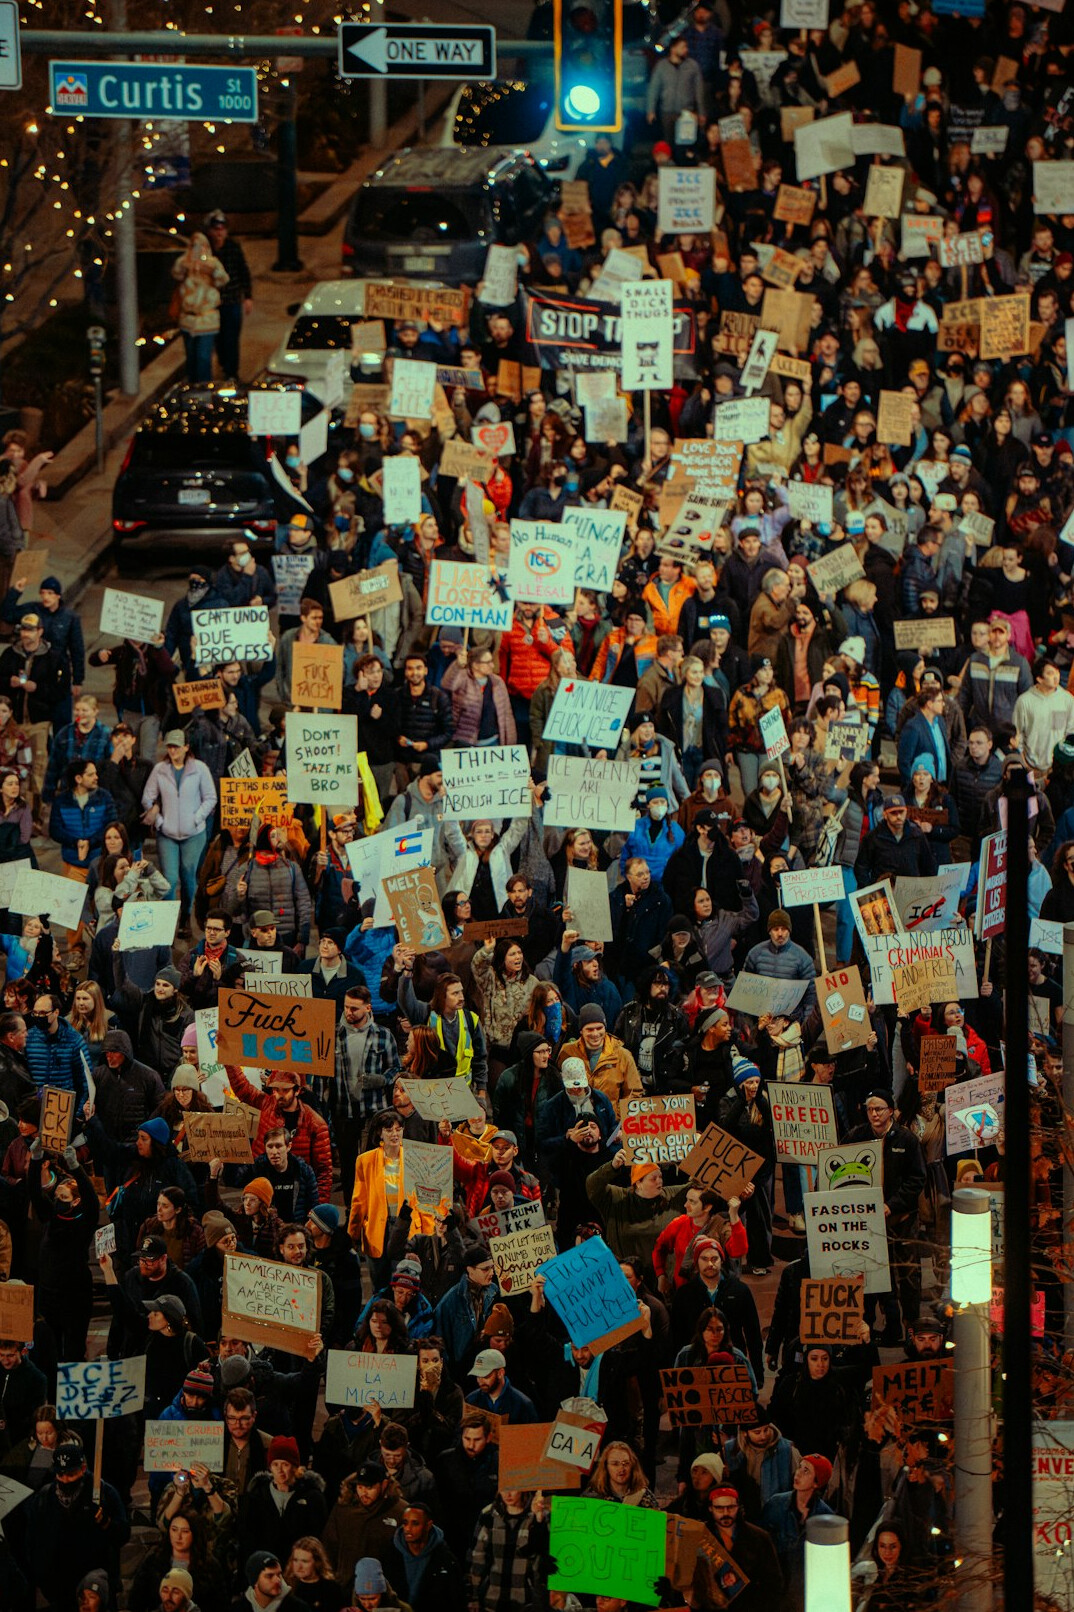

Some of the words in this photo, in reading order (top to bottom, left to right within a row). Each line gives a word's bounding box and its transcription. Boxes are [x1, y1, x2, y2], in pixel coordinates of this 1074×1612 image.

[387, 41, 427, 60] ONE
[435, 43, 477, 61] WAY
[99, 75, 203, 110] Curtis
[226, 78, 242, 94] St
[218, 95, 251, 110] 1000
[625, 287, 668, 298] SMALL
[630, 298, 668, 308] DICK
[540, 308, 598, 339] STOP
[626, 309, 670, 319] THUGS
[435, 564, 485, 588] LIAR
[434, 586, 493, 607] LOSER
[233, 608, 268, 624] UNDO
[430, 606, 508, 626] CON-MAN
[200, 629, 233, 645] DUE
[200, 643, 271, 664] PROCESS
[303, 664, 331, 683] FUCK
[594, 690, 622, 713] NICE
[303, 728, 341, 741] DON'T
[549, 711, 583, 738] FUCK
[585, 716, 610, 742] ICE
[295, 743, 341, 760] SHOOT!
[453, 748, 521, 769] THINK
[303, 763, 331, 774] TAZE
[335, 764, 352, 775] ME
[551, 759, 571, 776] ICE
[582, 759, 640, 784] AGENTS
[226, 781, 240, 793] IF
[243, 781, 259, 792] THIS
[311, 779, 340, 791] BRO
[444, 794, 493, 814] ABOLISH
[498, 787, 532, 807] ICE
[555, 793, 623, 824] FUGLY
[386, 873, 420, 894] MELT
[989, 888, 1002, 910] US
[908, 903, 943, 920] ICE
[909, 931, 934, 949] NOT
[940, 928, 972, 947] ABOUT
[246, 980, 310, 998] HISTORY
[825, 972, 850, 991] NO
[225, 992, 307, 1037] Fuck
[923, 1039, 956, 1051] PRISON
[404, 1080, 465, 1098] FUCK
[774, 1089, 799, 1106] LAND
[808, 1091, 827, 1108] THE
[416, 1100, 454, 1118] ICE
[627, 1099, 657, 1117] get
[661, 1096, 691, 1112] your
[772, 1105, 830, 1125] GREED
[622, 1112, 694, 1135] GESTAPO
[778, 1122, 803, 1139] HOME
[812, 1124, 831, 1141] THE
[41, 1133, 67, 1152] ICE
[665, 1132, 690, 1145] our
[699, 1126, 757, 1178] FUCK
[694, 1157, 733, 1195] ICE
[477, 1214, 499, 1230] NO
[501, 1202, 540, 1221] TRUMP
[811, 1203, 877, 1217] FASCISM
[481, 1226, 501, 1239] NO
[818, 1221, 838, 1233] ON
[841, 1220, 868, 1232] THE
[517, 1234, 530, 1248] LET
[530, 1231, 551, 1245] THEM
[821, 1240, 870, 1252] ROCKS
[504, 1249, 529, 1263] NUMB
[532, 1244, 556, 1257] YOUR
[229, 1257, 316, 1289] IMMIGRANTS
[543, 1247, 599, 1291] FUCK
[253, 1281, 286, 1295] MAKE
[552, 1261, 617, 1313] TRUMP!
[805, 1284, 862, 1309] FUCK
[237, 1287, 293, 1309] AMERICA
[245, 1301, 295, 1323] GREAT!
[347, 1355, 398, 1371] CHINGA
[58, 1360, 128, 1386] ICE
[365, 1373, 382, 1384] LA
[662, 1369, 695, 1388] NO
[707, 1366, 750, 1385] ICE
[345, 1387, 407, 1405] MIGRA!
[665, 1389, 701, 1408] NO
[58, 1403, 123, 1421] NUTS
[668, 1409, 703, 1426] NO
[711, 1407, 758, 1424] KINGS
[551, 1432, 594, 1460] CAVA
[553, 1500, 647, 1542] ICE
